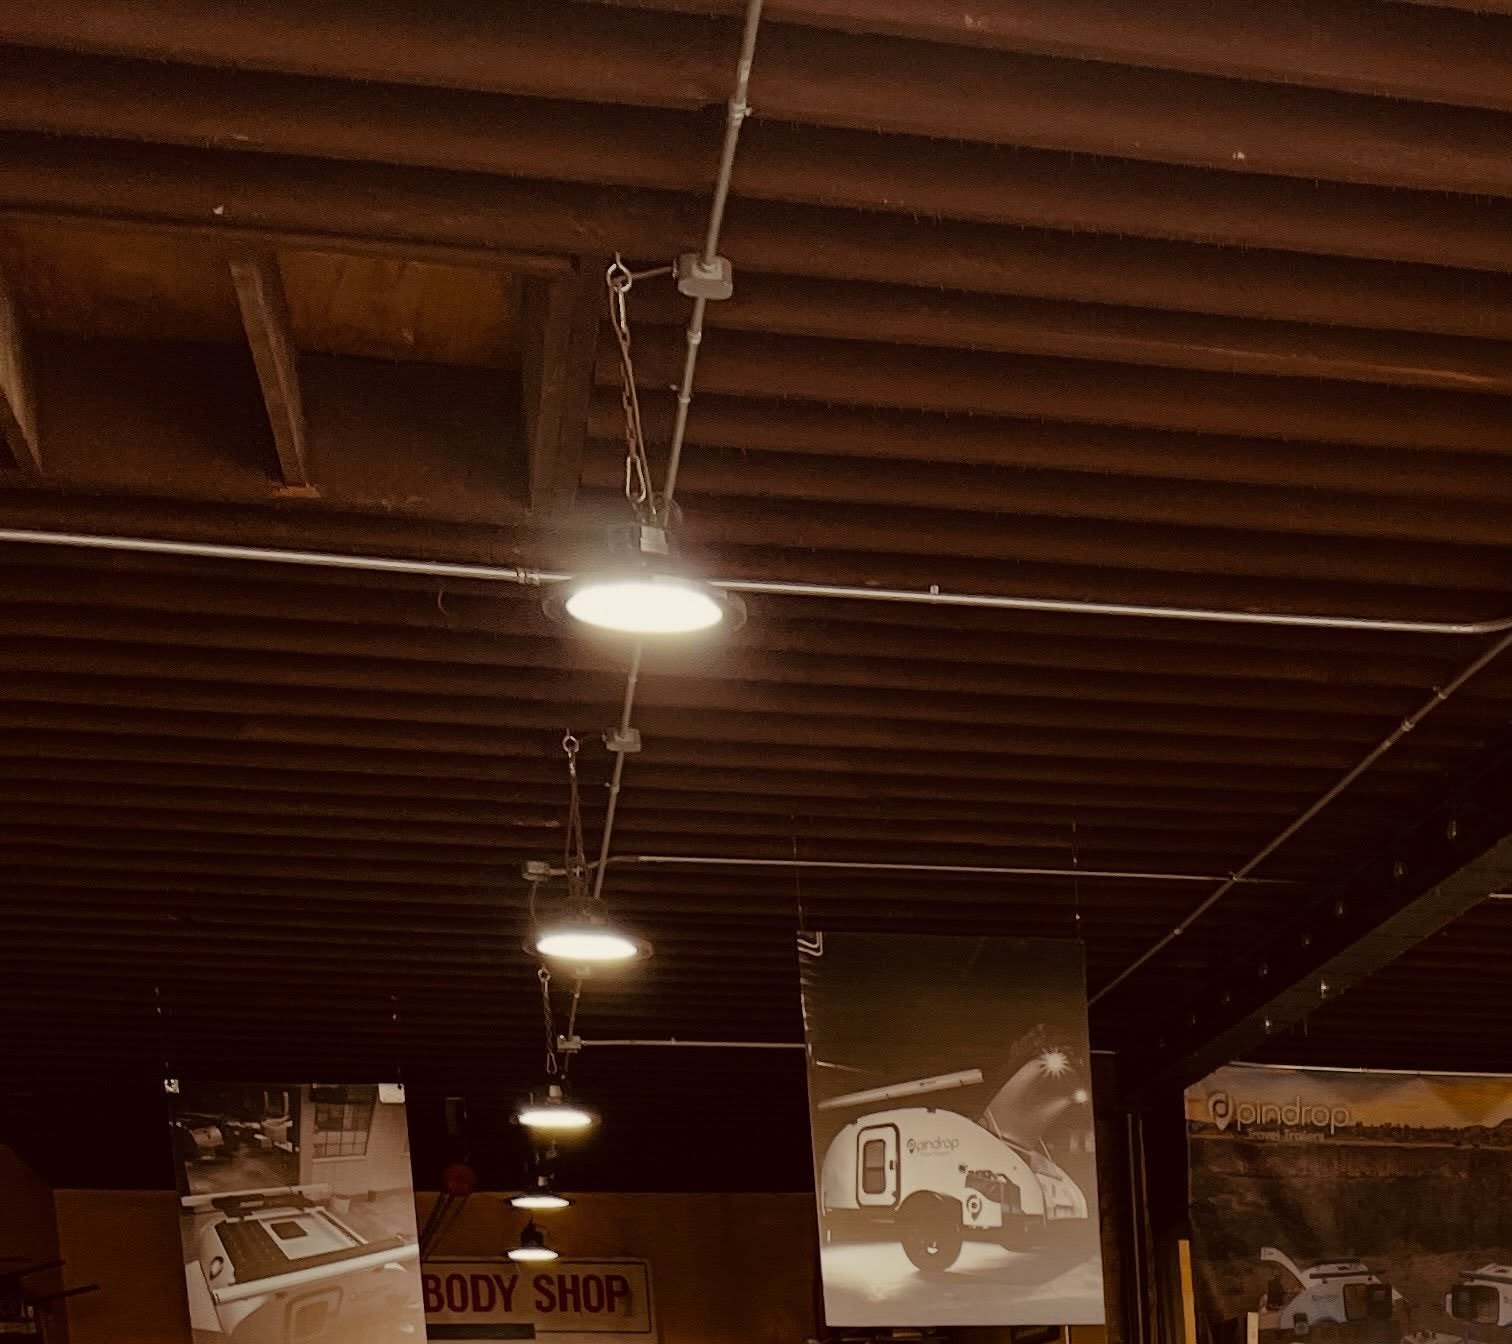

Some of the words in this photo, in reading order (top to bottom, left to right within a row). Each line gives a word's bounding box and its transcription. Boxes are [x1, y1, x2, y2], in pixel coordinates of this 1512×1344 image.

[1237, 1095, 1350, 1135] pindrop
[423, 1273, 518, 1313] BODY
[533, 1273, 630, 1313] SHOP
